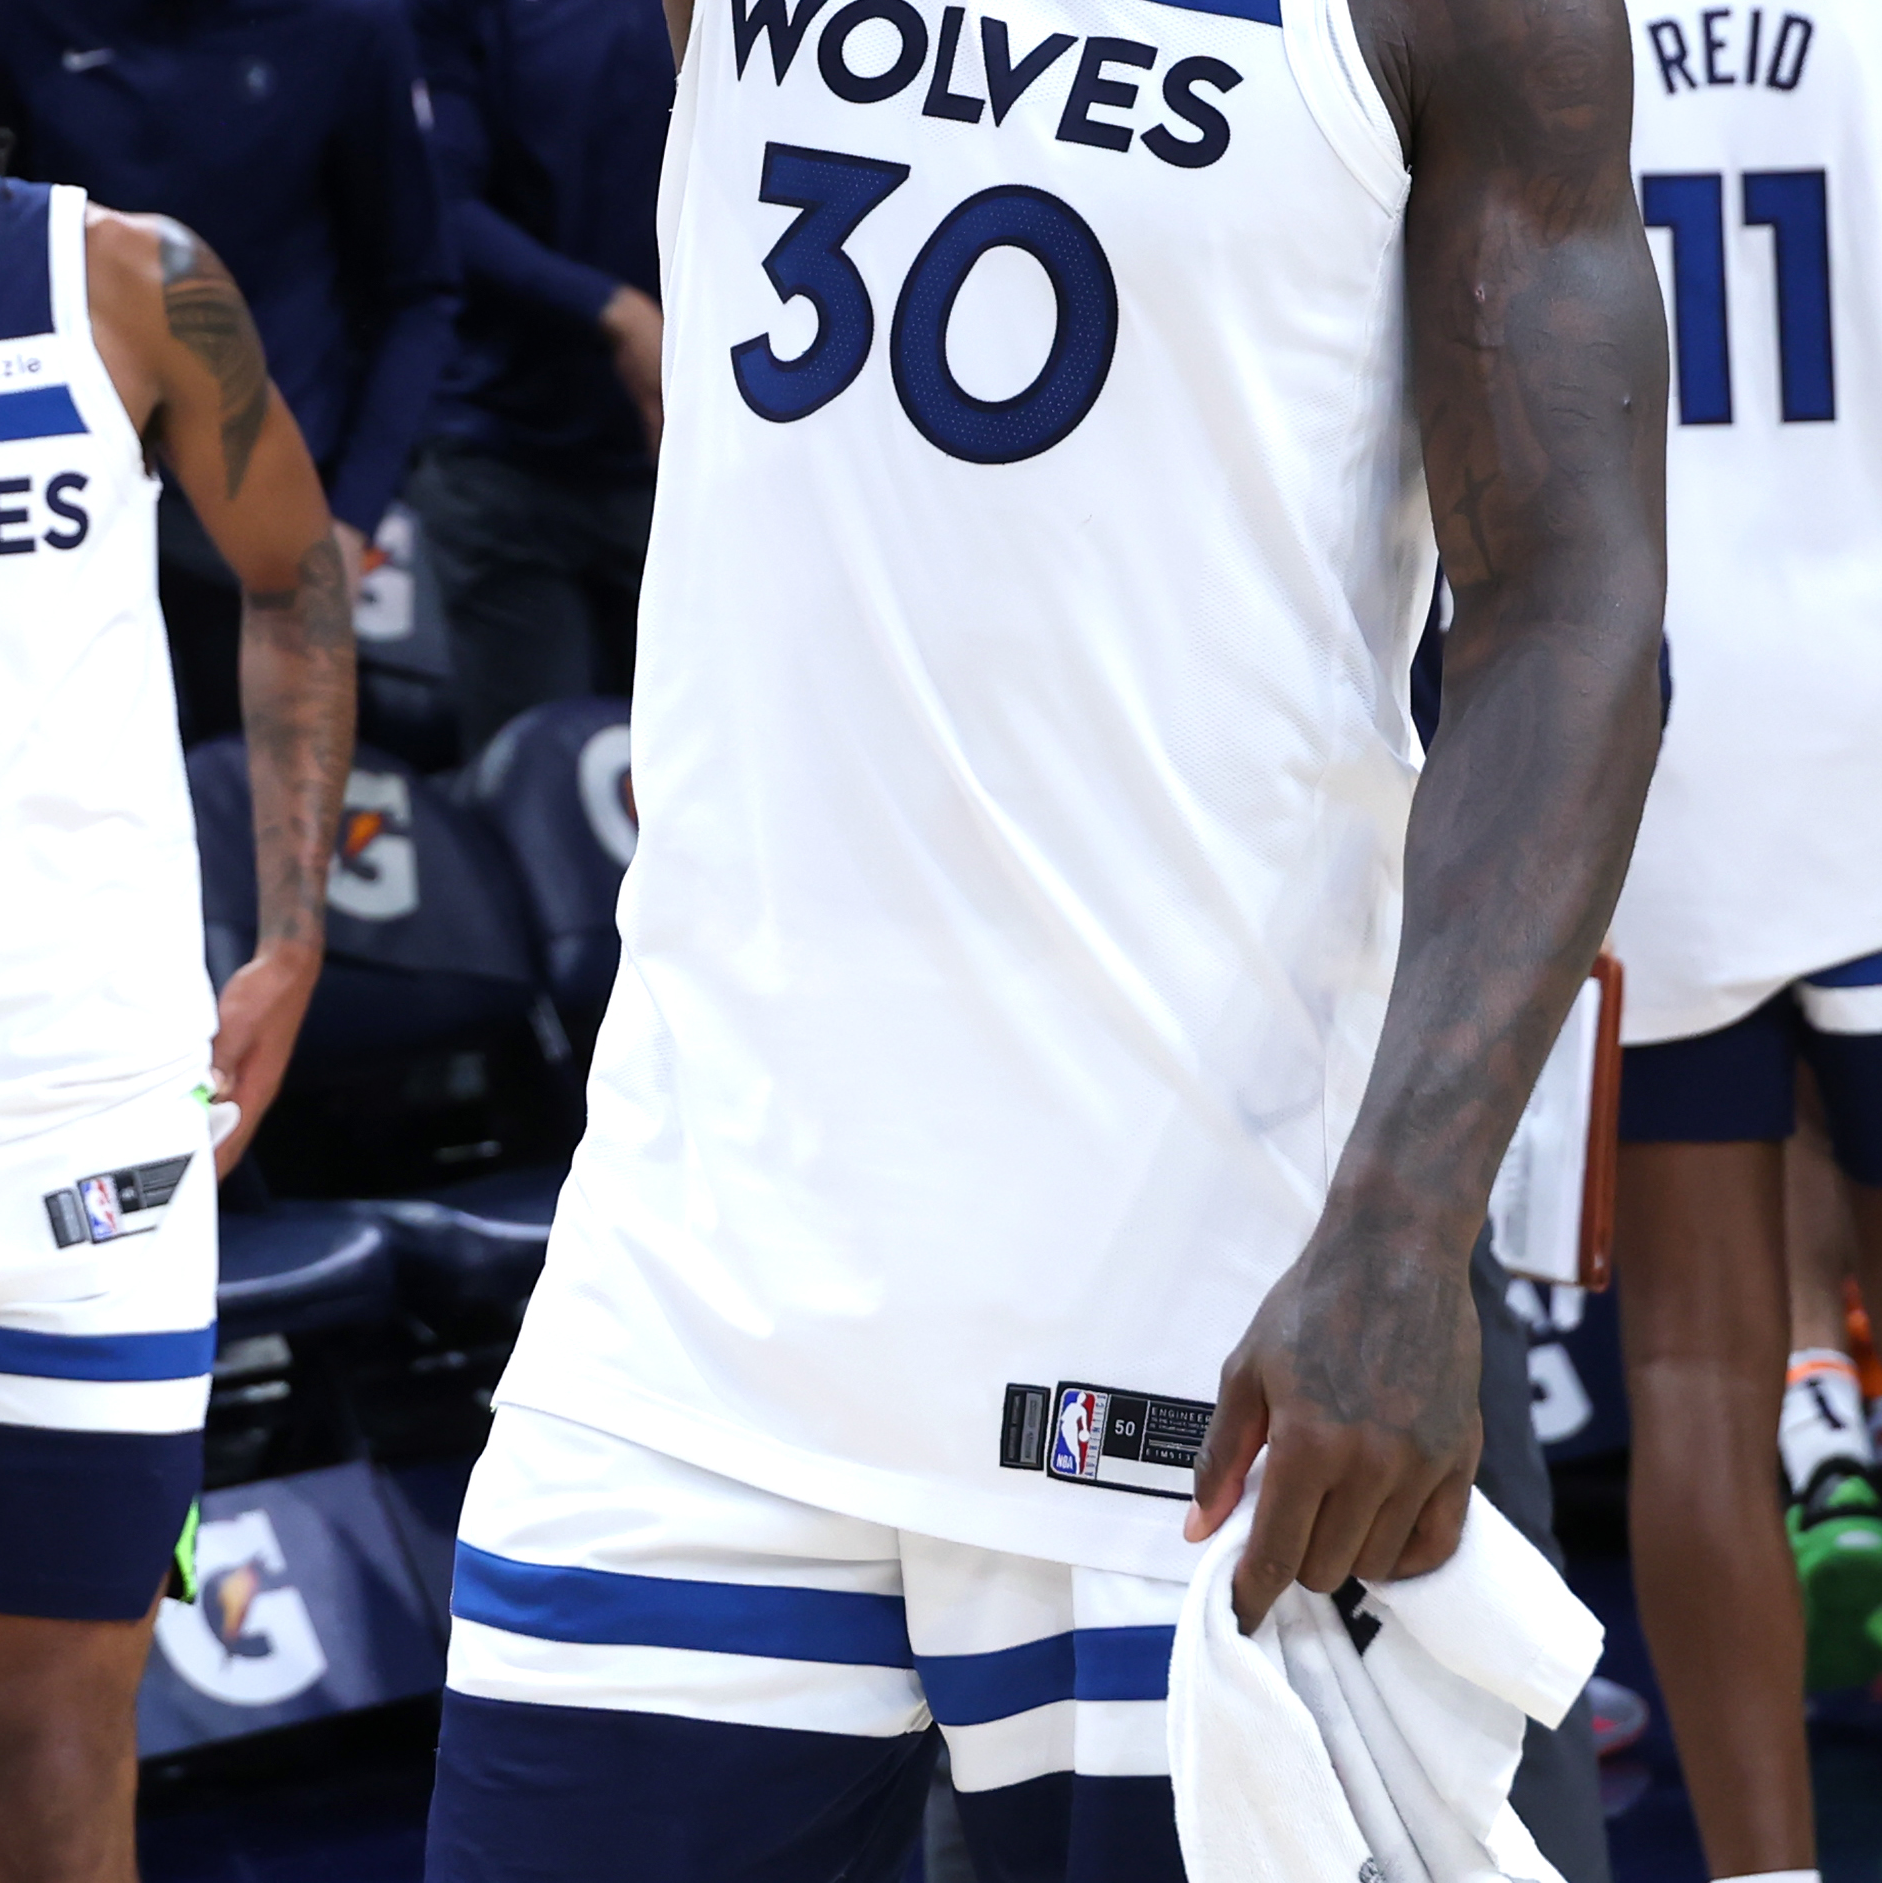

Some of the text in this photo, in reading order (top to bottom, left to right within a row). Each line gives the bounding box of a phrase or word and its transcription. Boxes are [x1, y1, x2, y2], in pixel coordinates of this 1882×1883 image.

[1648, 7, 1813, 94] REID
[729, 141, 1118, 465] 30
[1642, 168, 1836, 426] 11
[1056, 1453, 1074, 1470] NBA
[1114, 1419, 1136, 1437] 50
[154, 1508, 328, 1706] G
